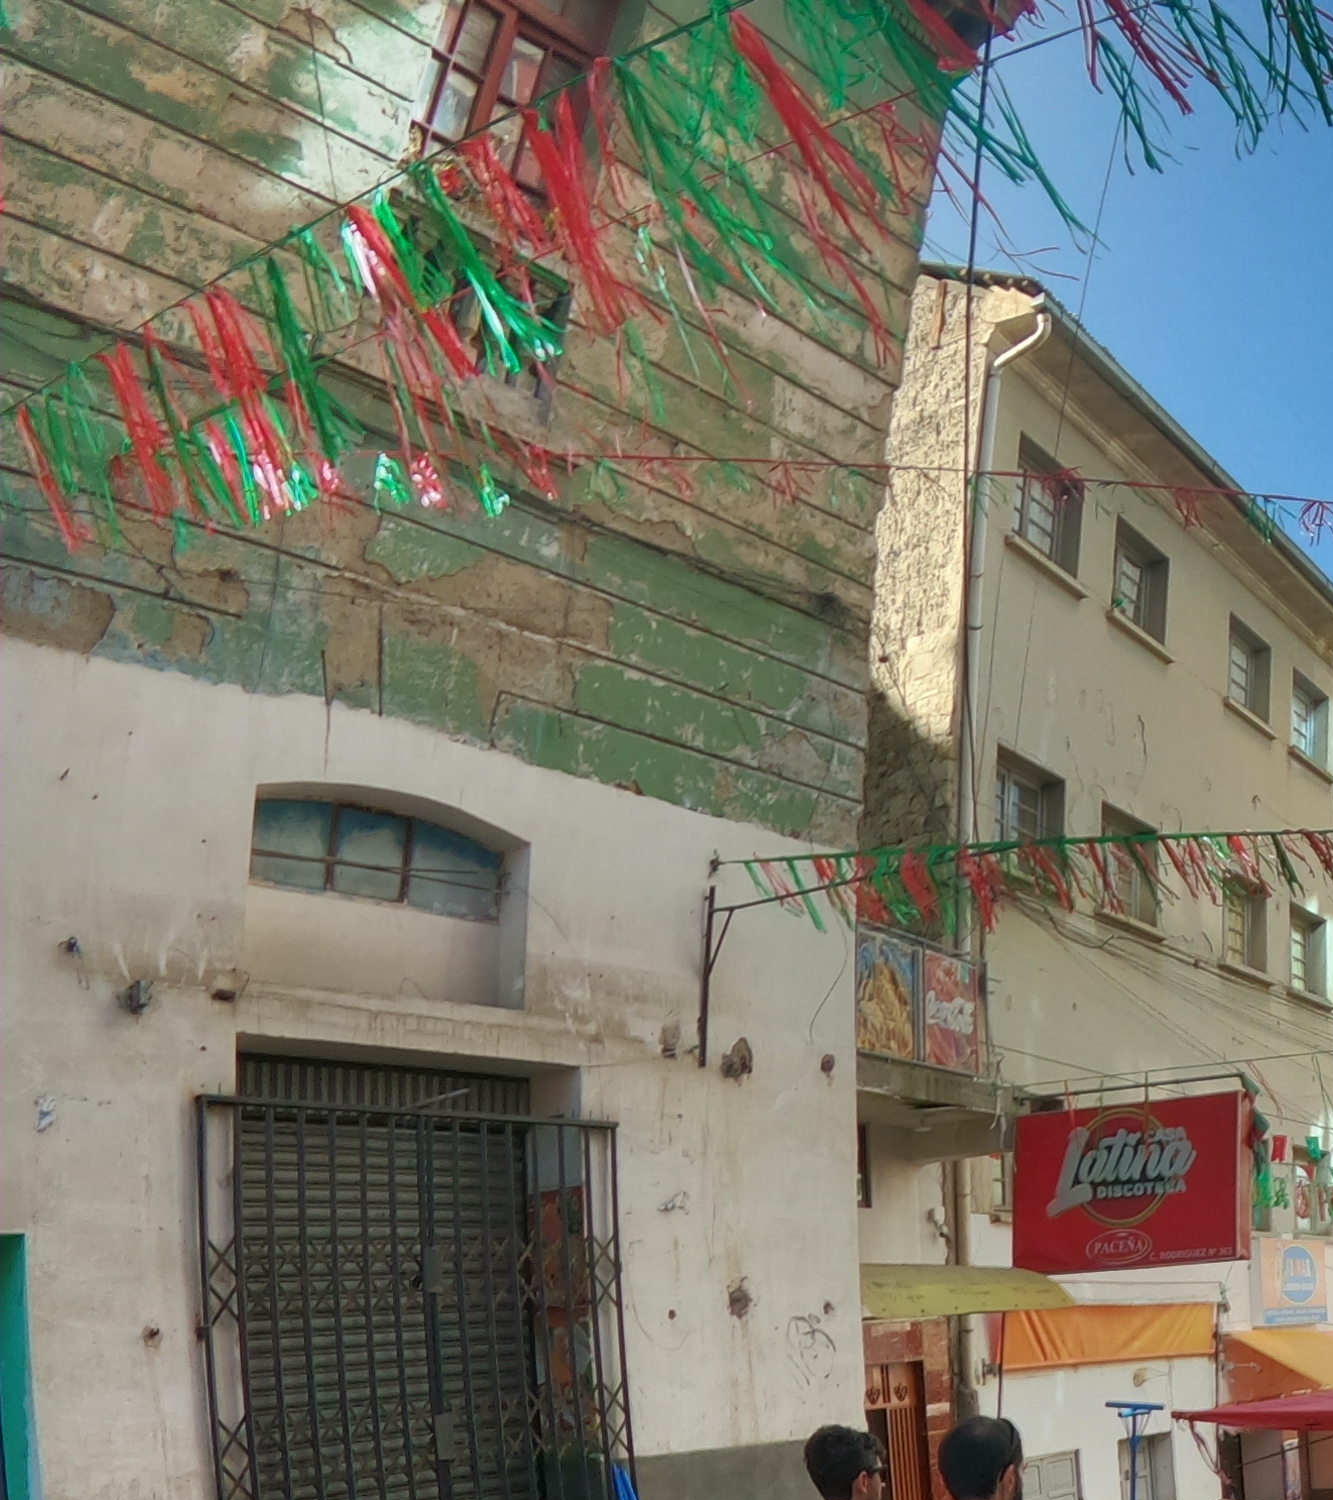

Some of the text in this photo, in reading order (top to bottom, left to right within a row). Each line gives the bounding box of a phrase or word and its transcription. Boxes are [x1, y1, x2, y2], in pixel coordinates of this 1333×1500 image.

[1046, 1126, 1197, 1219] Latina
[1096, 1178, 1187, 1199] DISCOTECA
[1093, 1236, 1144, 1255] PACEÑA
